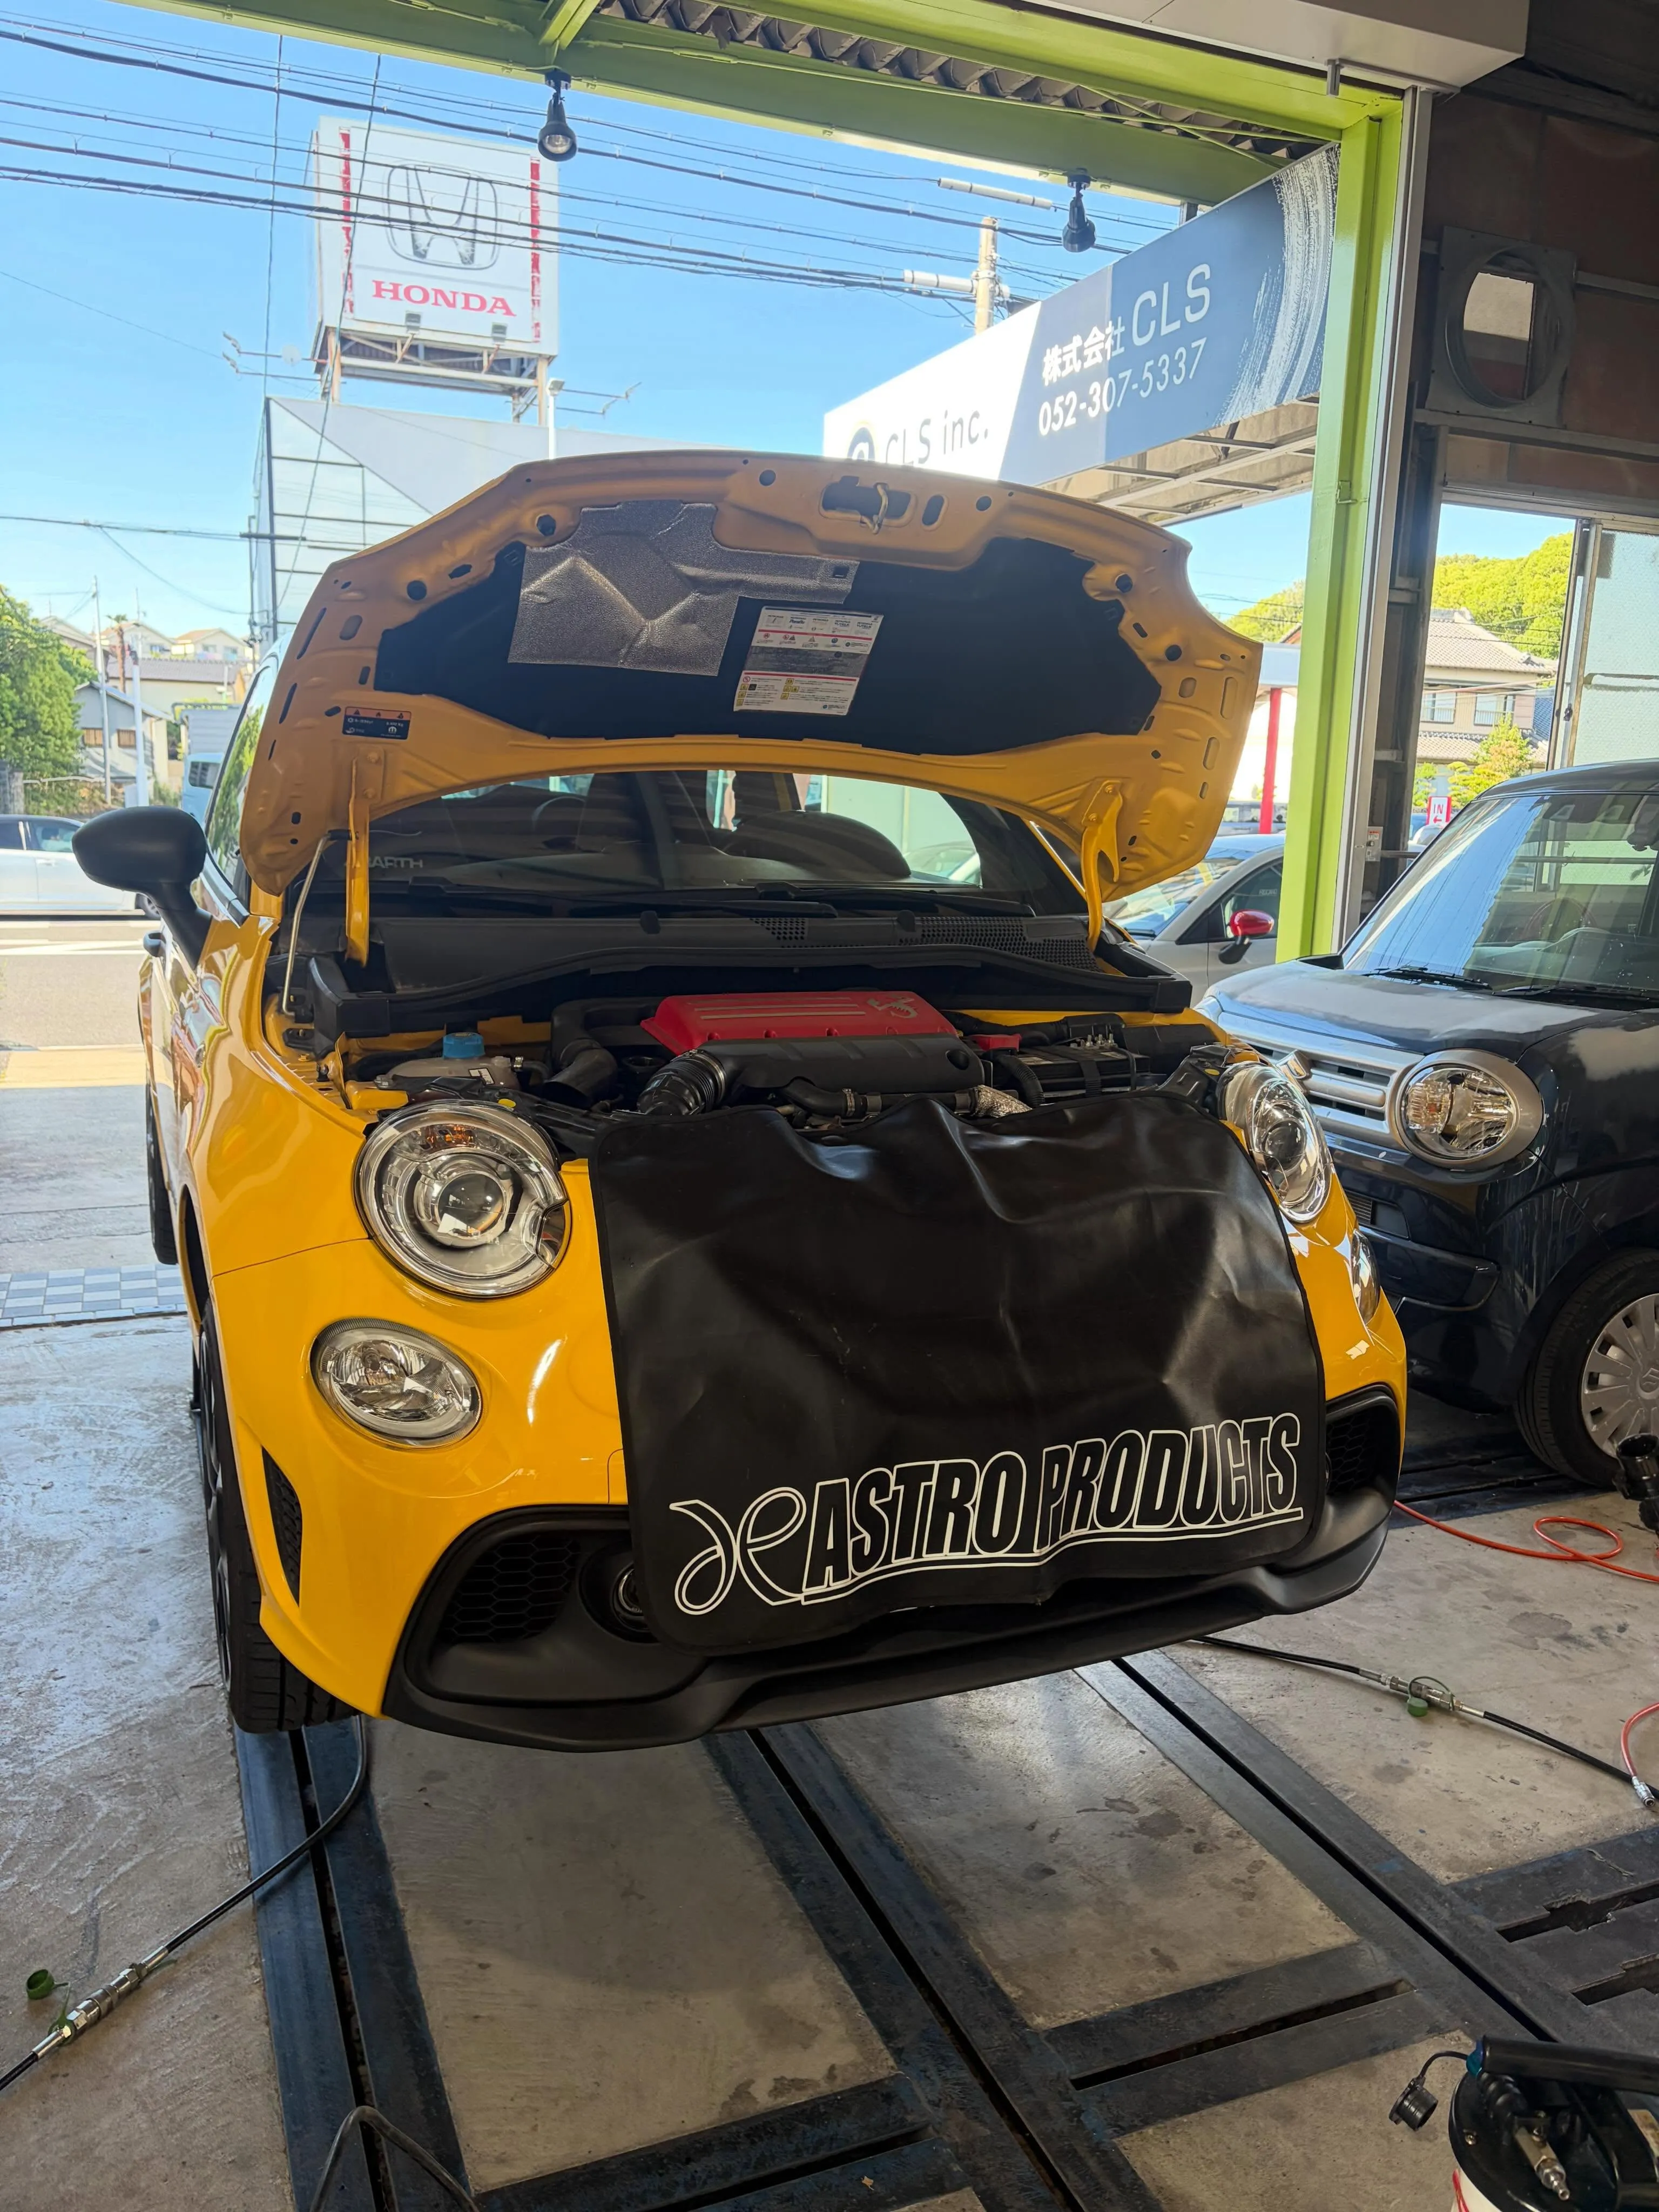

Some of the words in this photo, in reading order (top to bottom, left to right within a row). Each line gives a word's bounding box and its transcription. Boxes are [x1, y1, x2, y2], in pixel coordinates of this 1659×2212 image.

[372, 280, 517, 316] HONDA
[1042, 316, 1125, 386] 株式会社
[1132, 263, 1211, 346] CLS
[1038, 337, 1207, 435] 052-307-5337
[943, 409, 988, 455] inc.
[1433, 804, 1444, 814] IN
[368, 856, 423, 868] ARTH
[802, 1451, 1027, 1593] ASTRO
[1033, 1412, 1300, 1554] PRODUCTS
